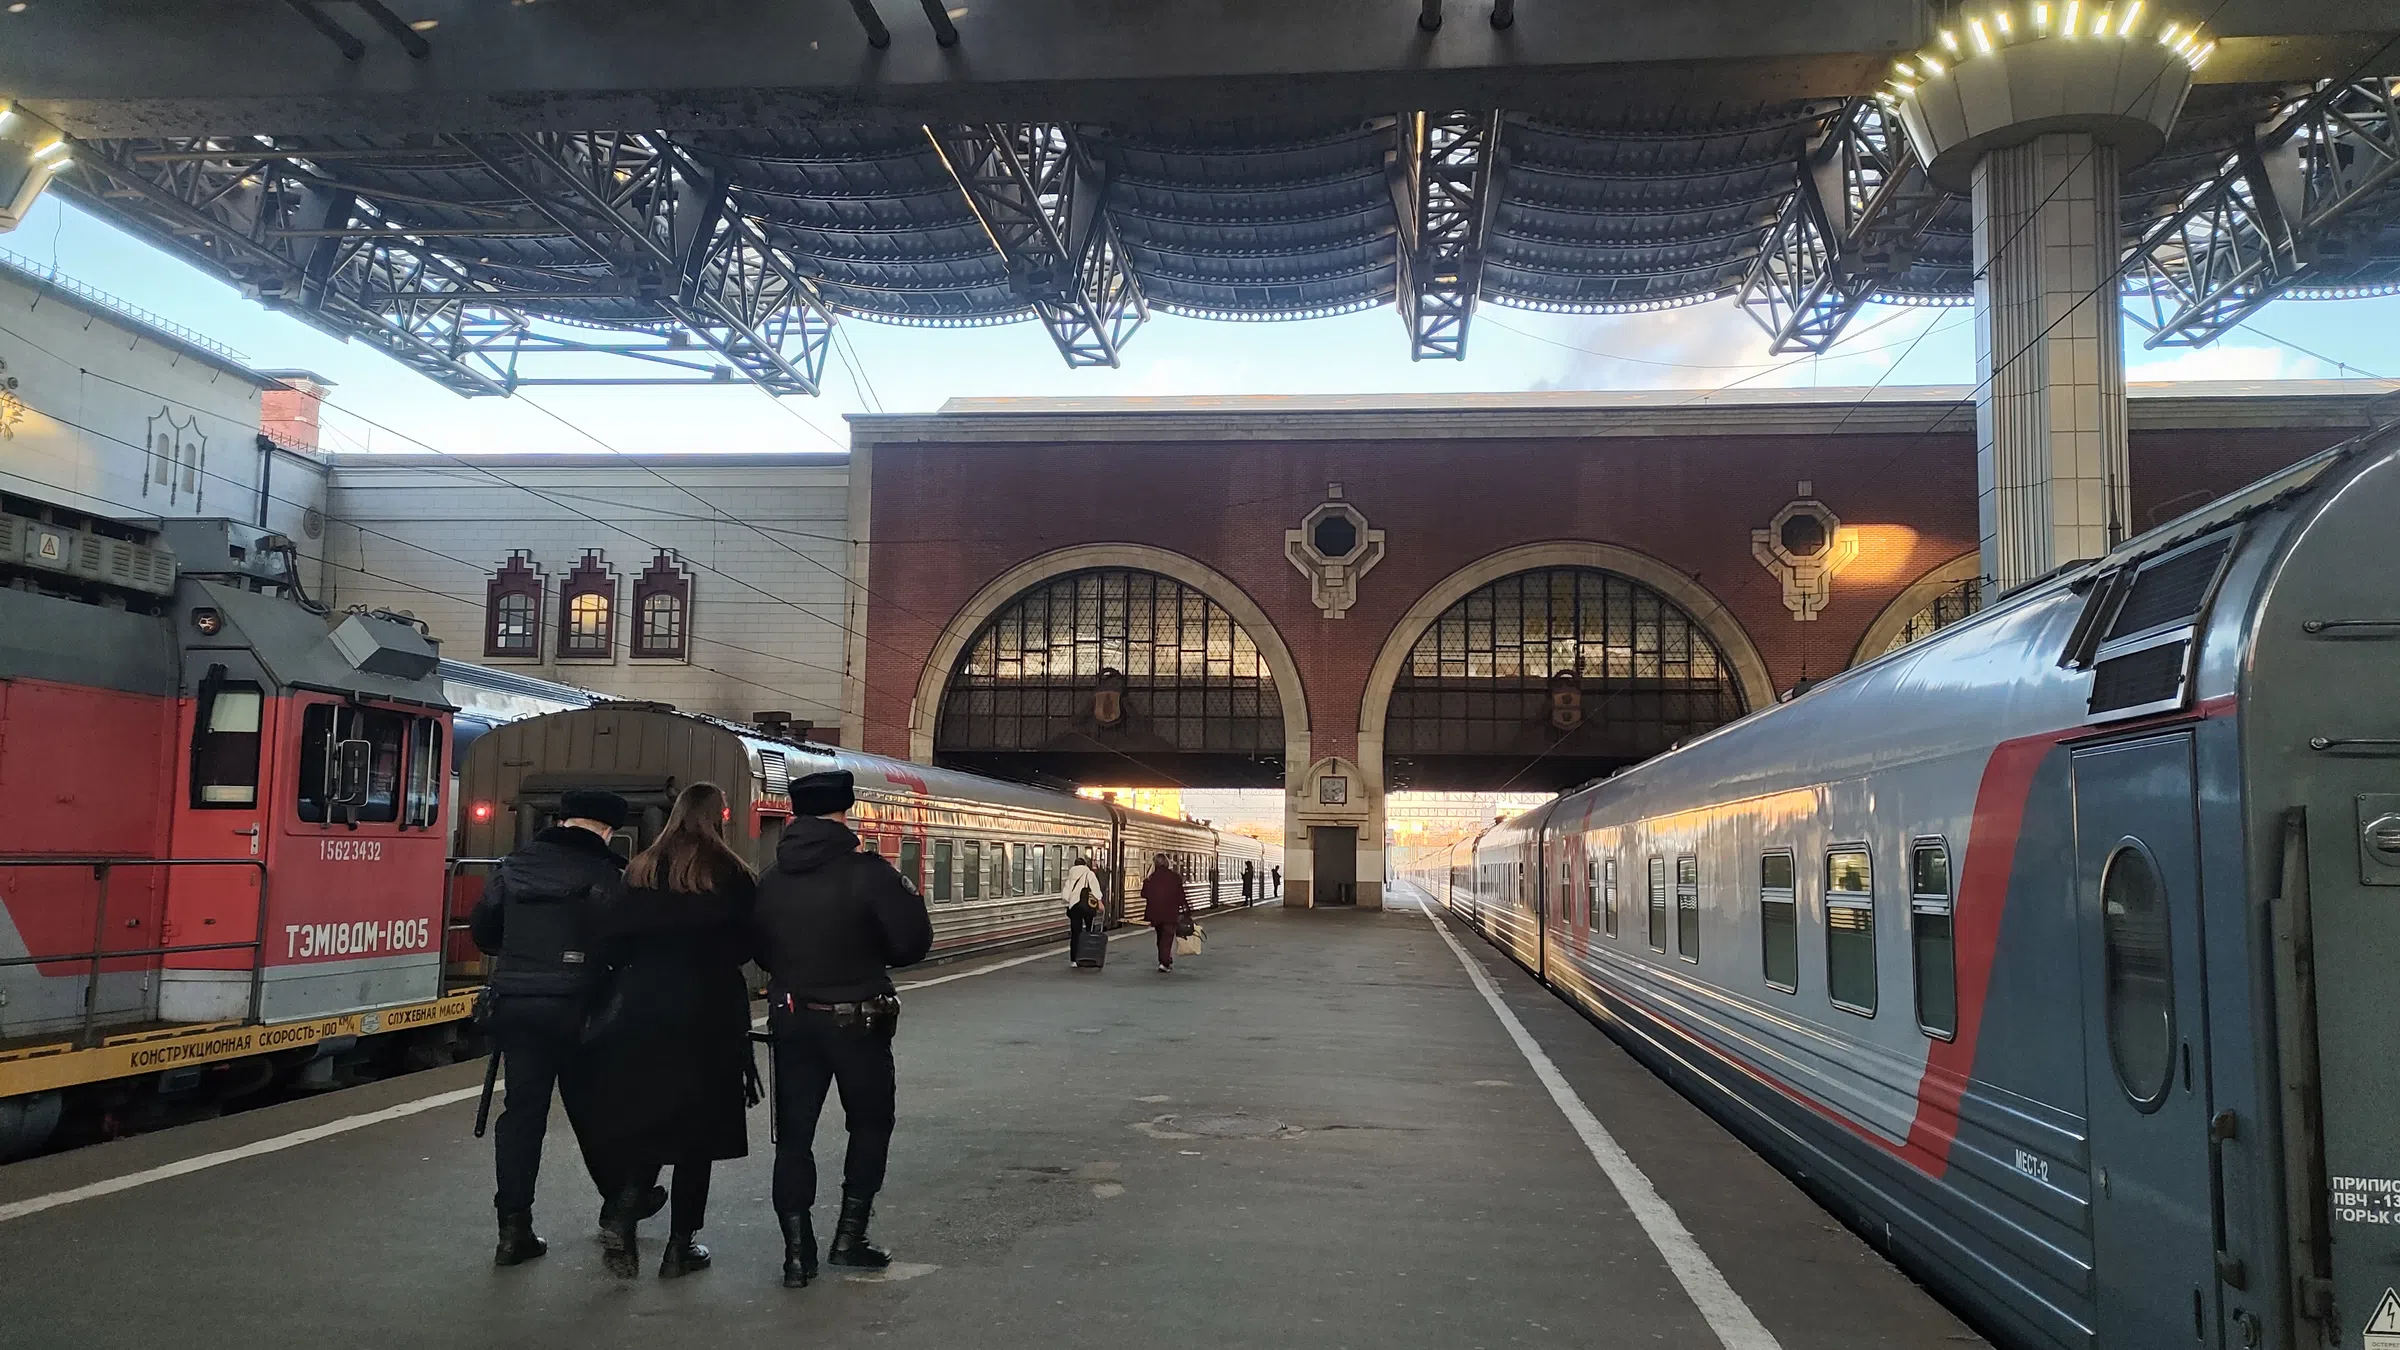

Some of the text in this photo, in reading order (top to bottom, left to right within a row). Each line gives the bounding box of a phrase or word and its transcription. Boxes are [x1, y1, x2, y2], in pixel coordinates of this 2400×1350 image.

[320, 840, 381, 861] 15623432
[285, 918, 429, 958] ТЭМ18ДМ-1805
[387, 1007, 437, 1025] СЛУЖЕБНАЯ
[439, 1002, 466, 1017] МАССА
[130, 1035, 251, 1068] КОНСТРУКЦИОННАЯ
[2332, 1176, 2400, 1193] ПРИПИС
[2335, 1208, 2390, 1224] ГОРЬК
